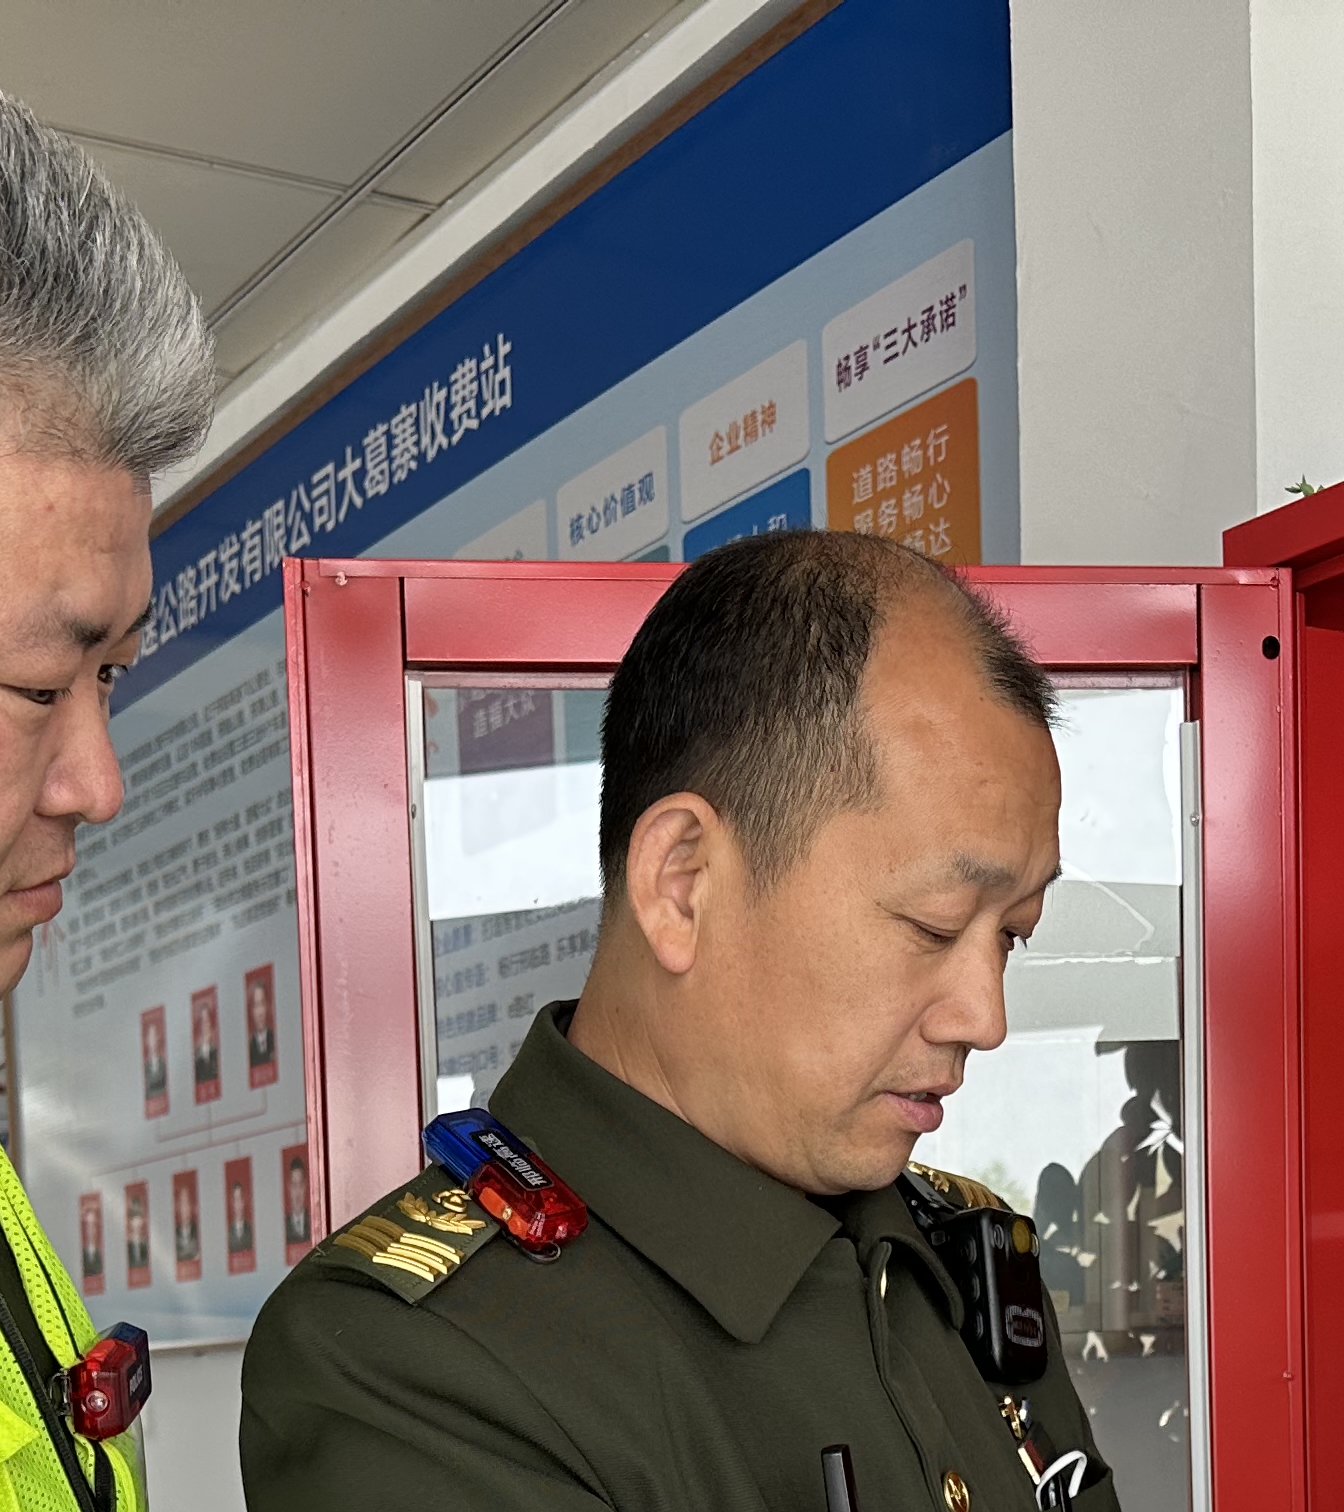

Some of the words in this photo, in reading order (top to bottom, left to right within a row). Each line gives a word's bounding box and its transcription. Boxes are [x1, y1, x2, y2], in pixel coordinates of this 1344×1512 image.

[708, 400, 777, 465] 企业精神
[852, 424, 950, 505] 道路畅行
[132, 333, 513, 667] 速公路开发有限公司大葛寨收费站
[569, 471, 656, 547] 核心价值观
